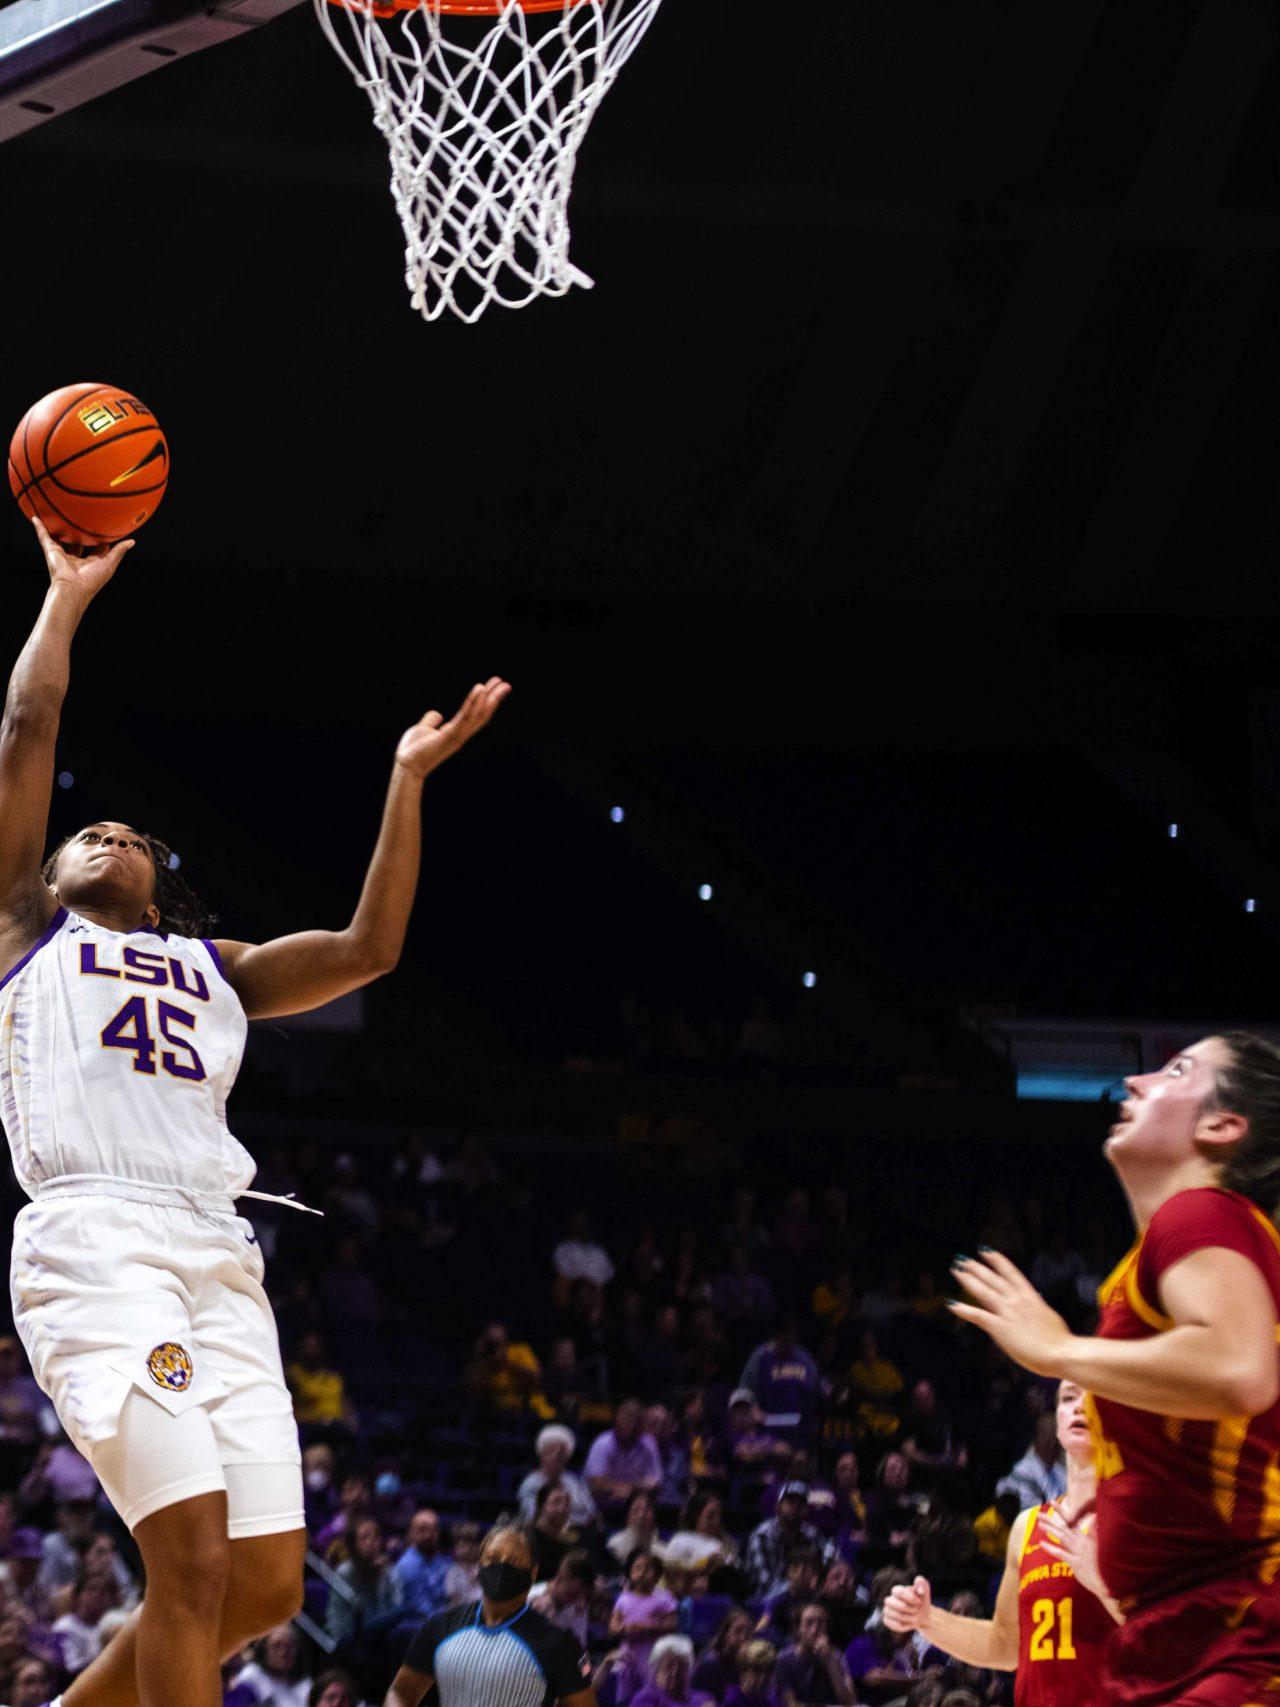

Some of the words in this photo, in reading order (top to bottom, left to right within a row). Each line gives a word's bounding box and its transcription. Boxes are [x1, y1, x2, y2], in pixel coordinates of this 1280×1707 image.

[79, 942, 211, 1002] LSU
[100, 994, 208, 1083] 45
[1030, 1598, 1076, 1661] 21
